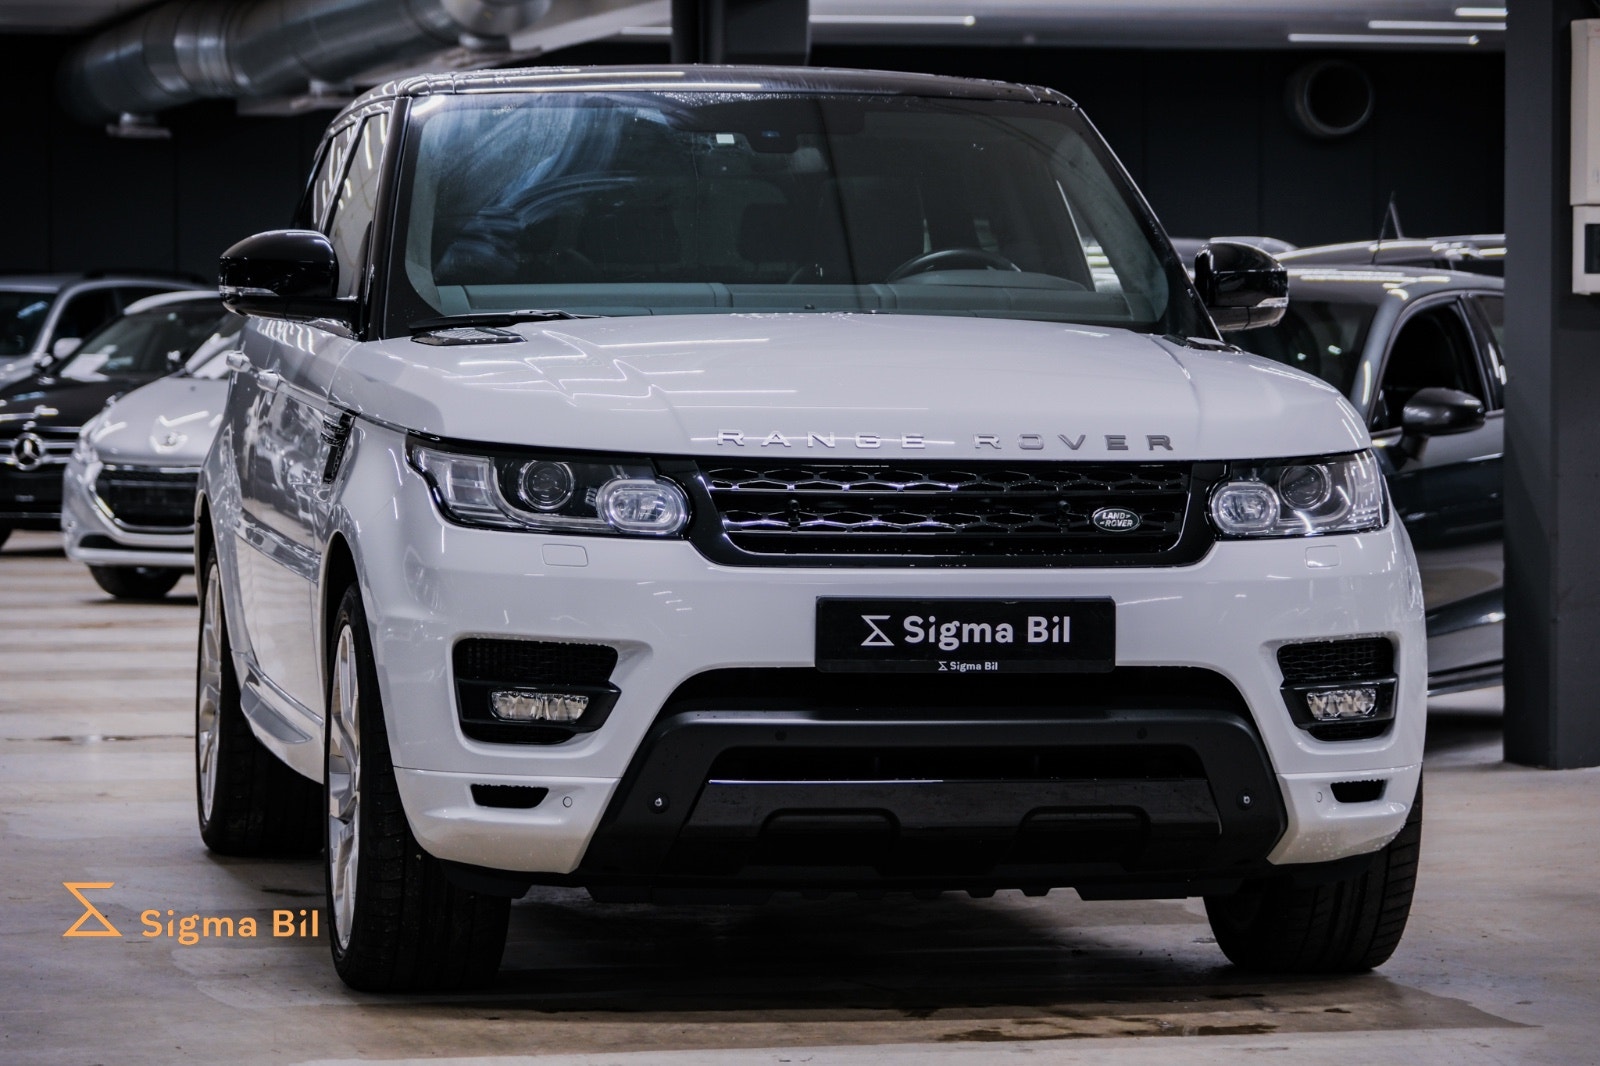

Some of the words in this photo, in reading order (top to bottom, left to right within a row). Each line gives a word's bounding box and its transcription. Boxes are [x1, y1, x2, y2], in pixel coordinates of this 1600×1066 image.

[717, 428, 927, 450] RANGE
[973, 433, 1175, 452] ROVER
[903, 615, 1014, 651] Sigma
[1027, 616, 1071, 643] Bil
[949, 661, 982, 673] Sigma
[984, 661, 998, 671] Bil
